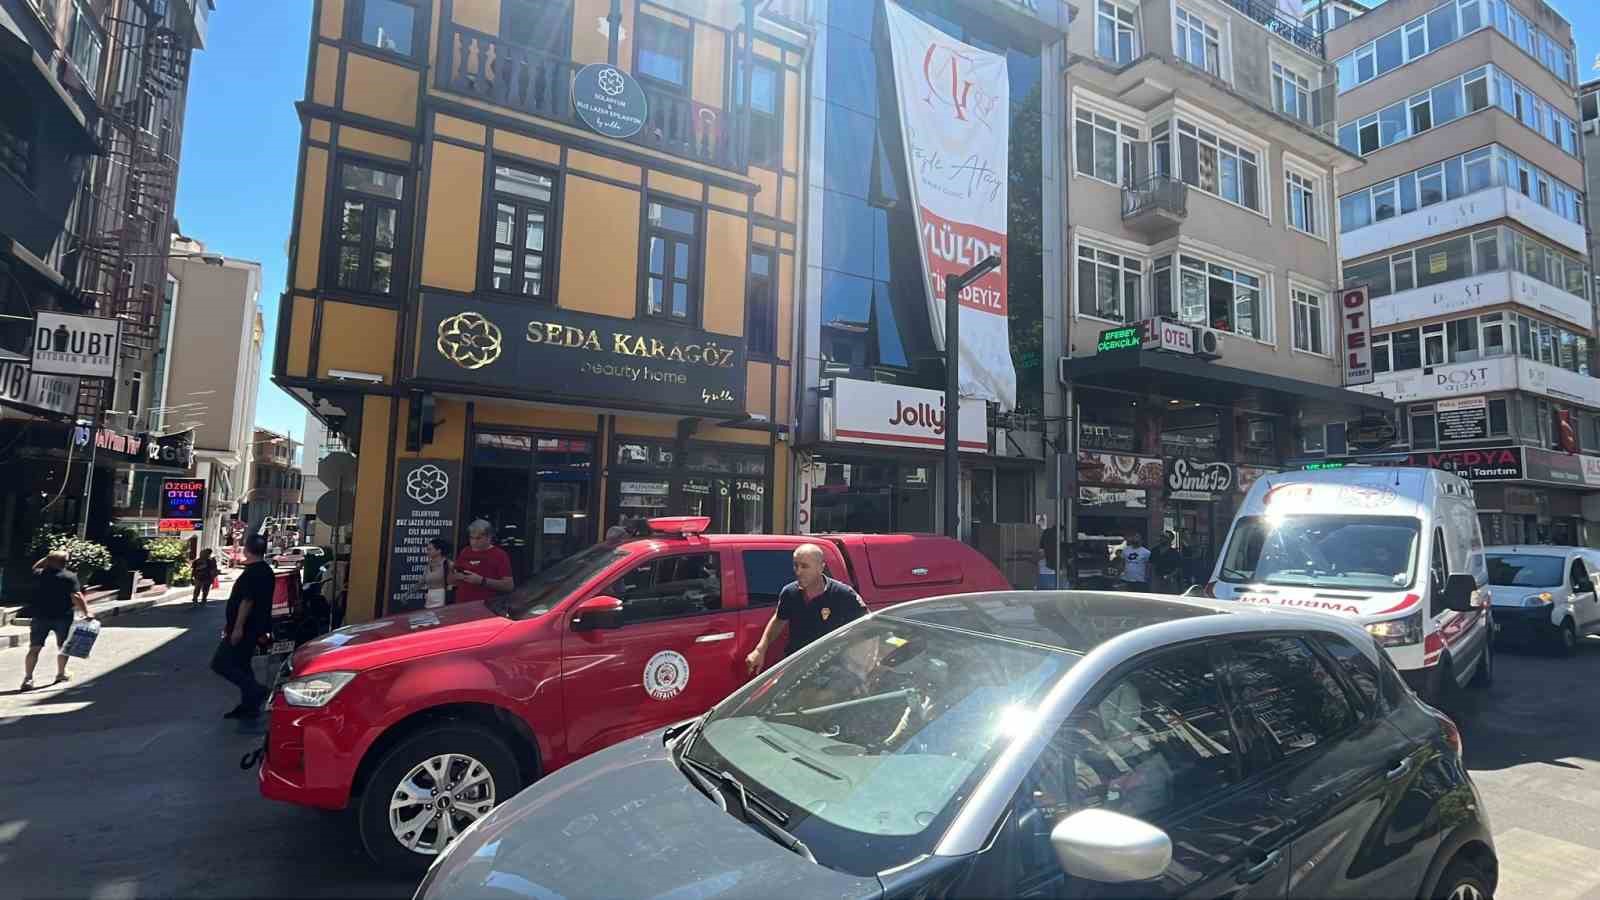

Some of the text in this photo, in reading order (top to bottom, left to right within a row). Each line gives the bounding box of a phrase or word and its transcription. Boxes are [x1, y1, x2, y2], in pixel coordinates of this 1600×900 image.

[526, 321, 736, 368] SEDA KARAGÖZ
[1165, 327, 1191, 348] OTEL
[1343, 290, 1367, 369] OTEL
[643, 365, 688, 385] home
